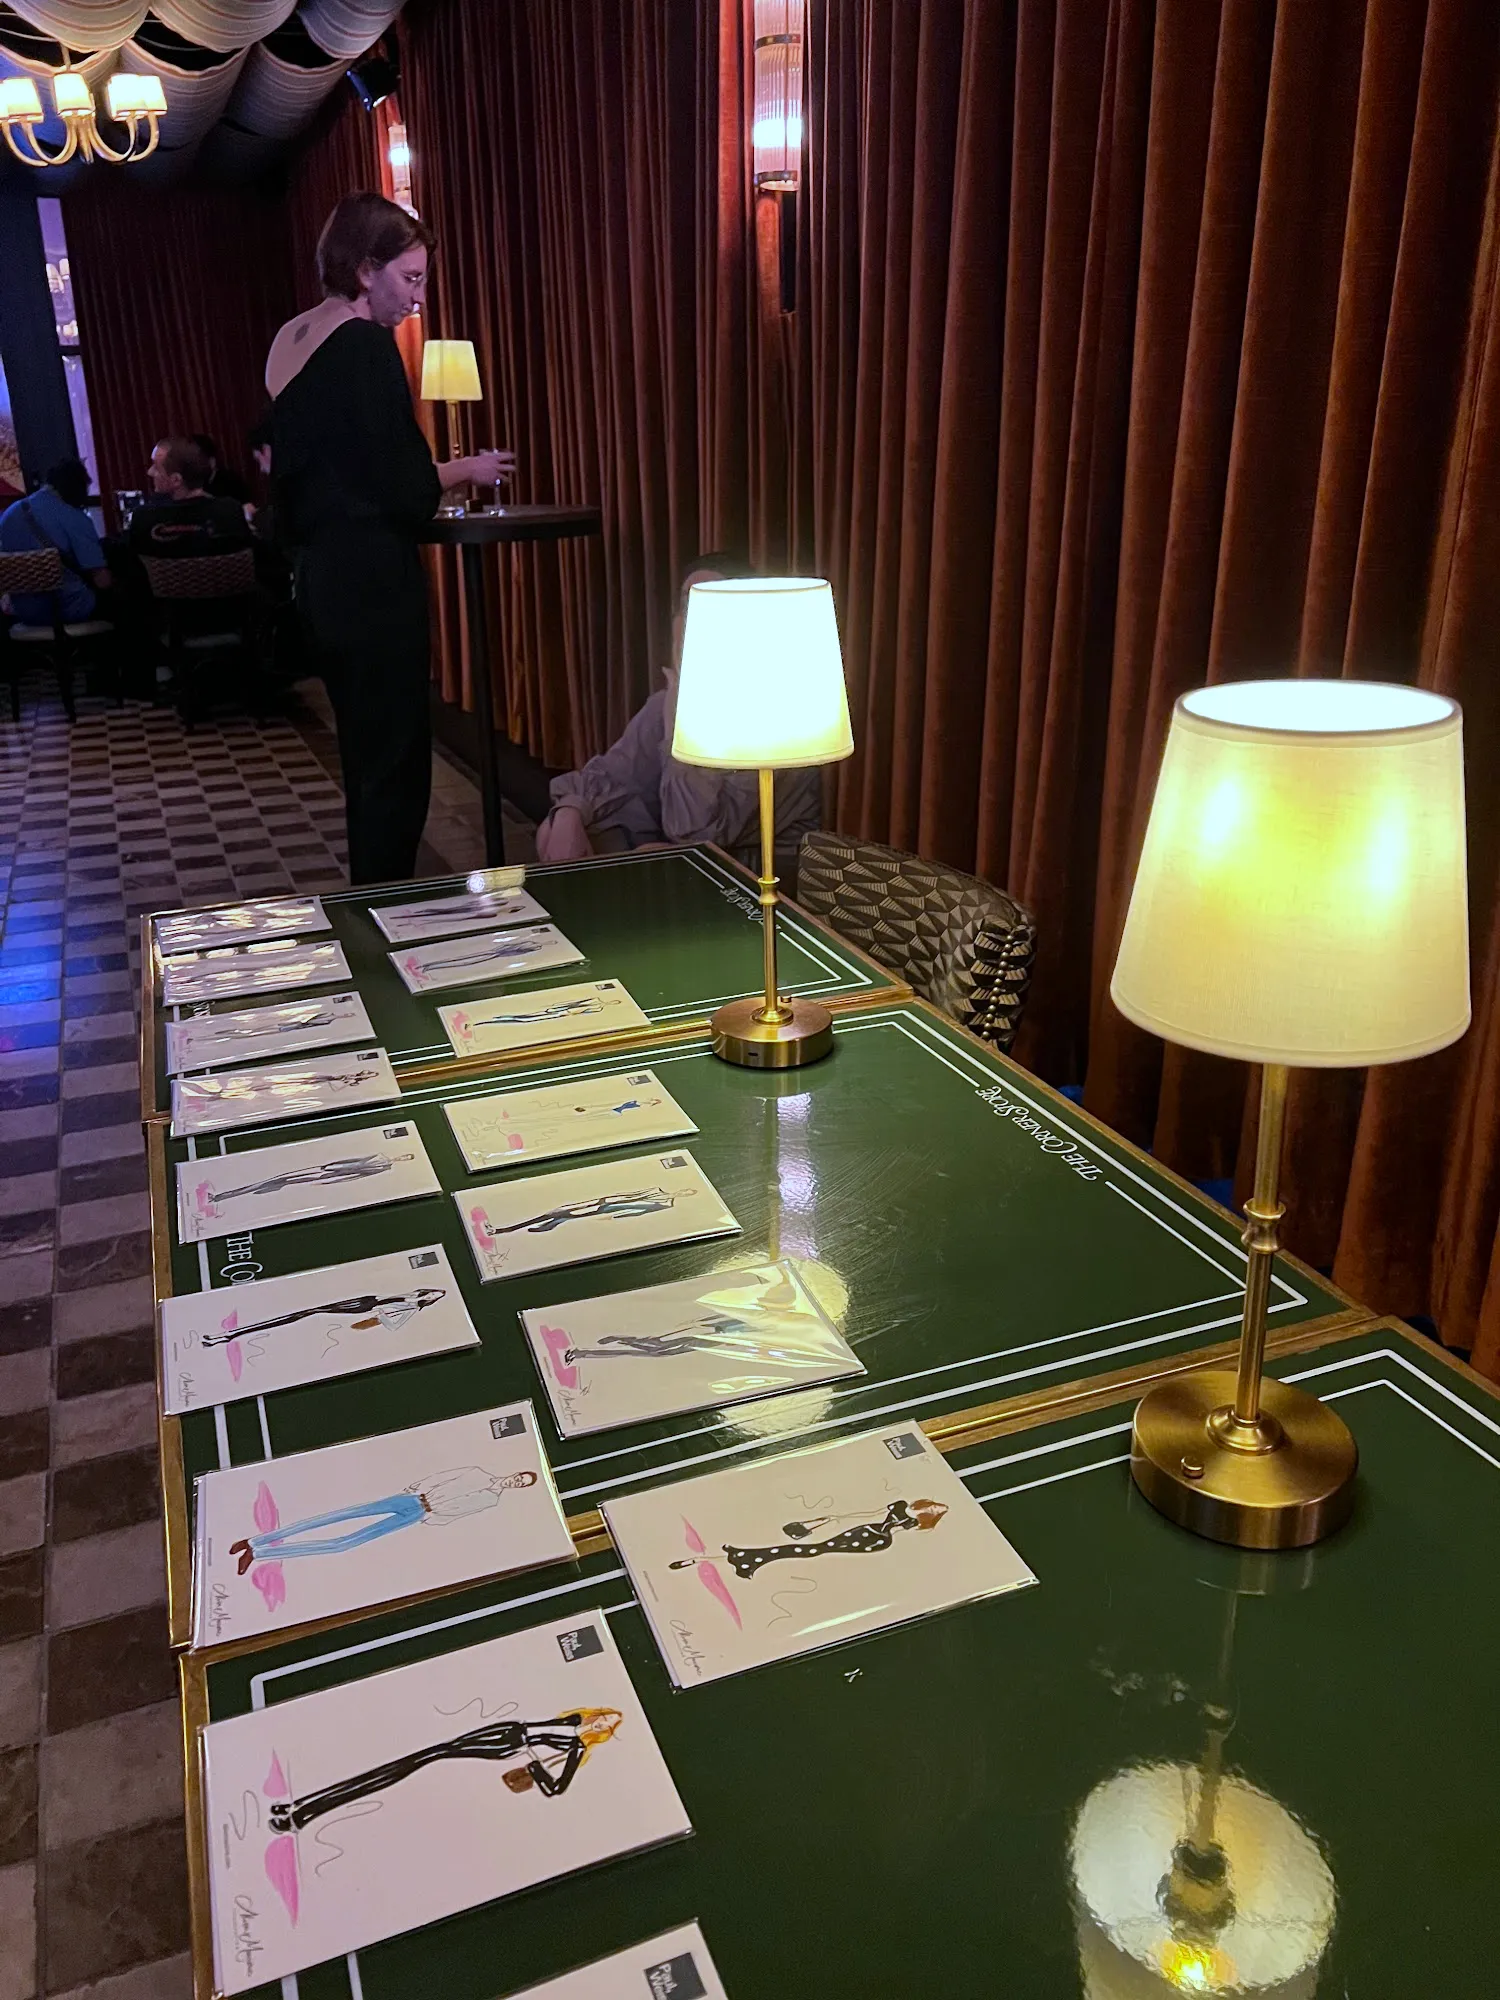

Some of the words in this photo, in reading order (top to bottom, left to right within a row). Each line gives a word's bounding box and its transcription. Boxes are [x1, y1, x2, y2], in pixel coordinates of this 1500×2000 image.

[975, 1086, 1029, 1116] STORE
[1012, 1115, 1078, 1153] CORNER
[1061, 1153, 1103, 1180] THE
[226, 1231, 254, 1261] THE
[220, 1262, 263, 1286] CO
